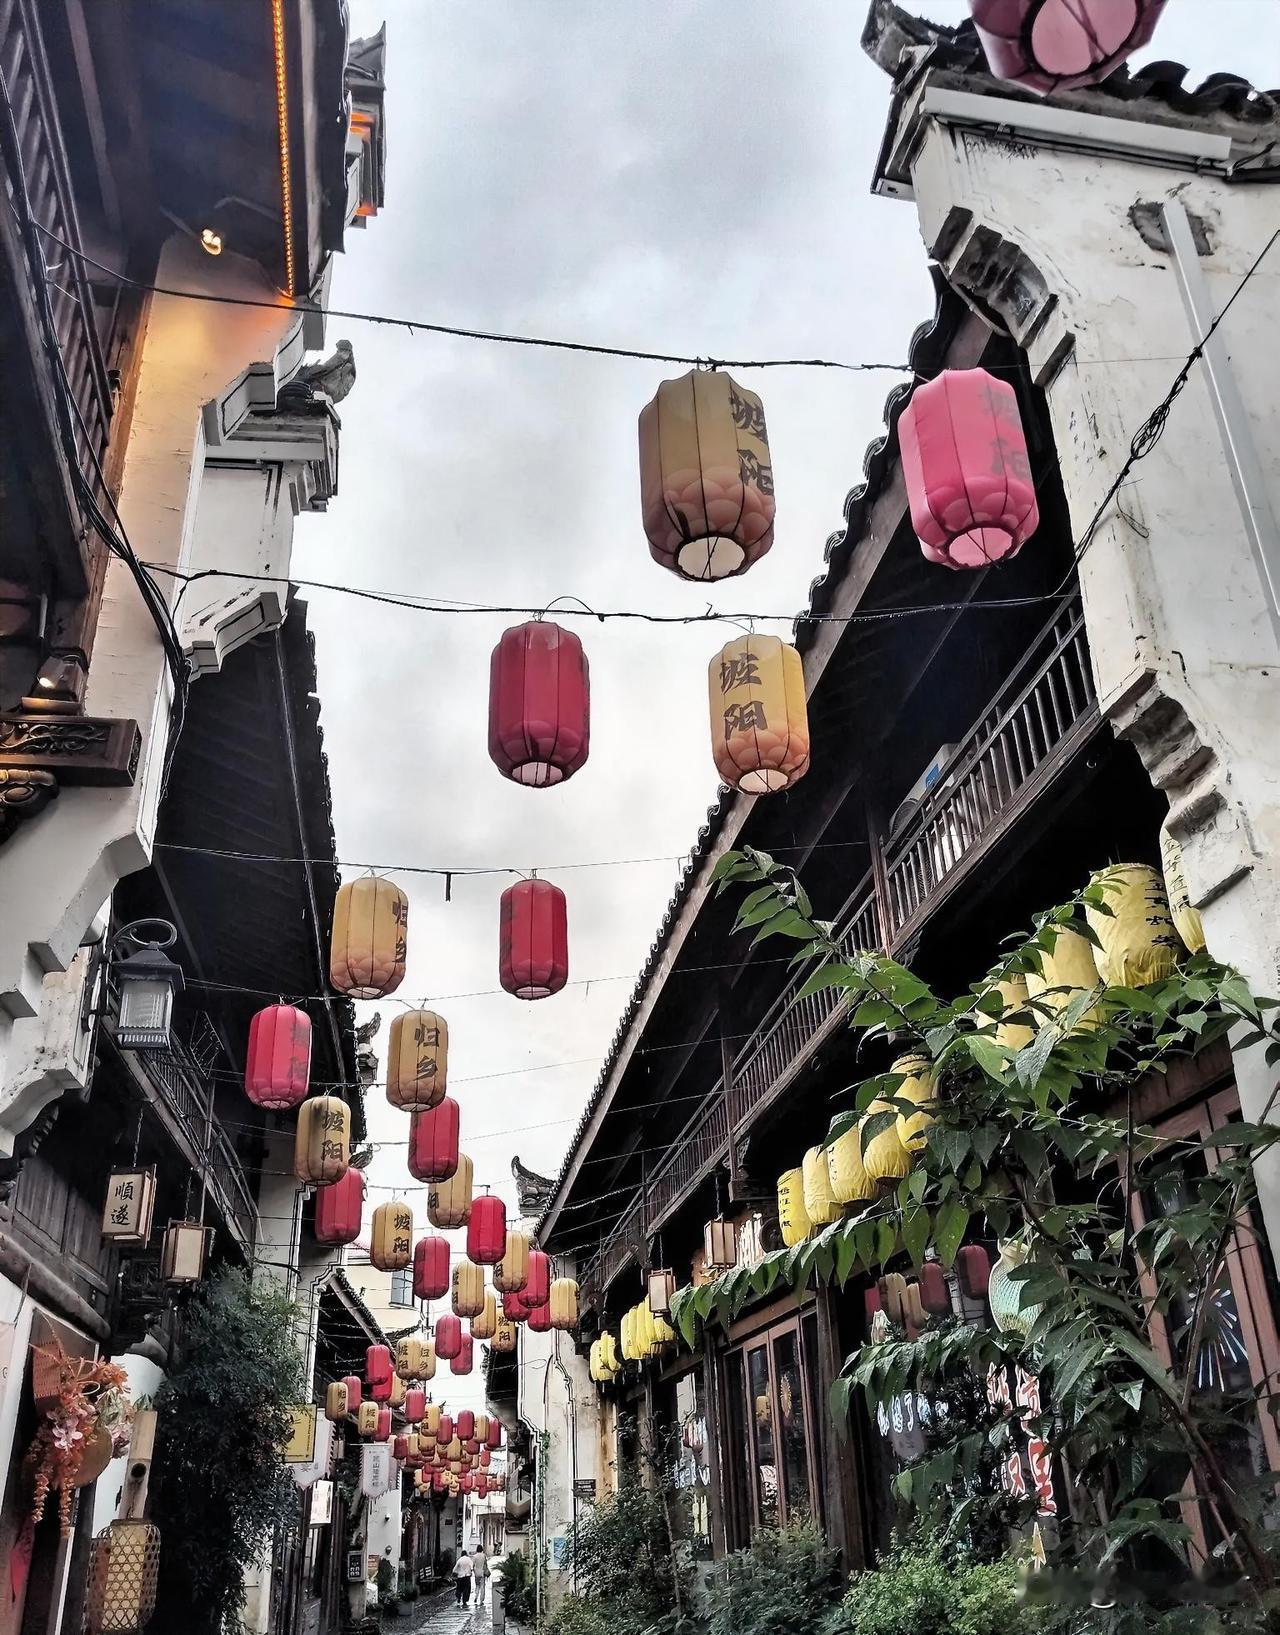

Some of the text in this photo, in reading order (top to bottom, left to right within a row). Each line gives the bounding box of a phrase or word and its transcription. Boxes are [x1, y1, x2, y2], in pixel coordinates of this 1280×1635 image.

[720, 653, 768, 740] 坡阳
[413, 1024, 440, 1081] 归乡
[321, 1110, 344, 1162] 坡阳
[111, 1181, 134, 1226] 順遂
[393, 1213, 411, 1254] 坡阳
